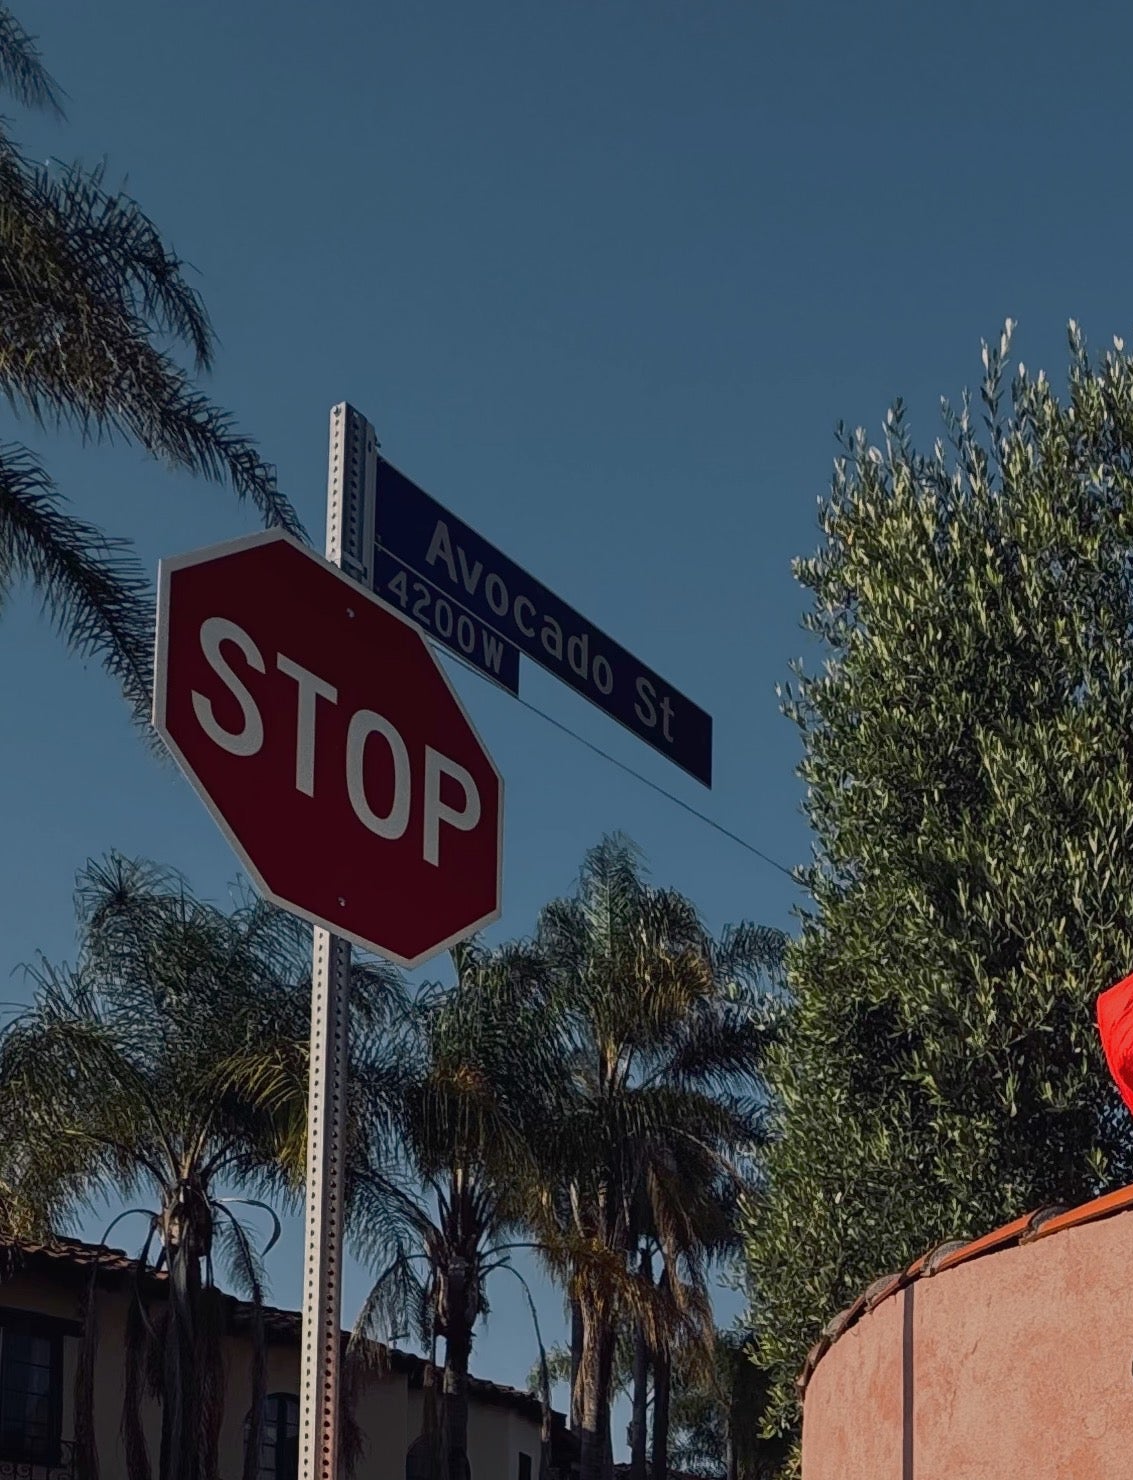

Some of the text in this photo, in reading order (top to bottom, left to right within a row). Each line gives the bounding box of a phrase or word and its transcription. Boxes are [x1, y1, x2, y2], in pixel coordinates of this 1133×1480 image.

[191, 617, 481, 867] STOP
[425, 520, 675, 743] Avocado St
